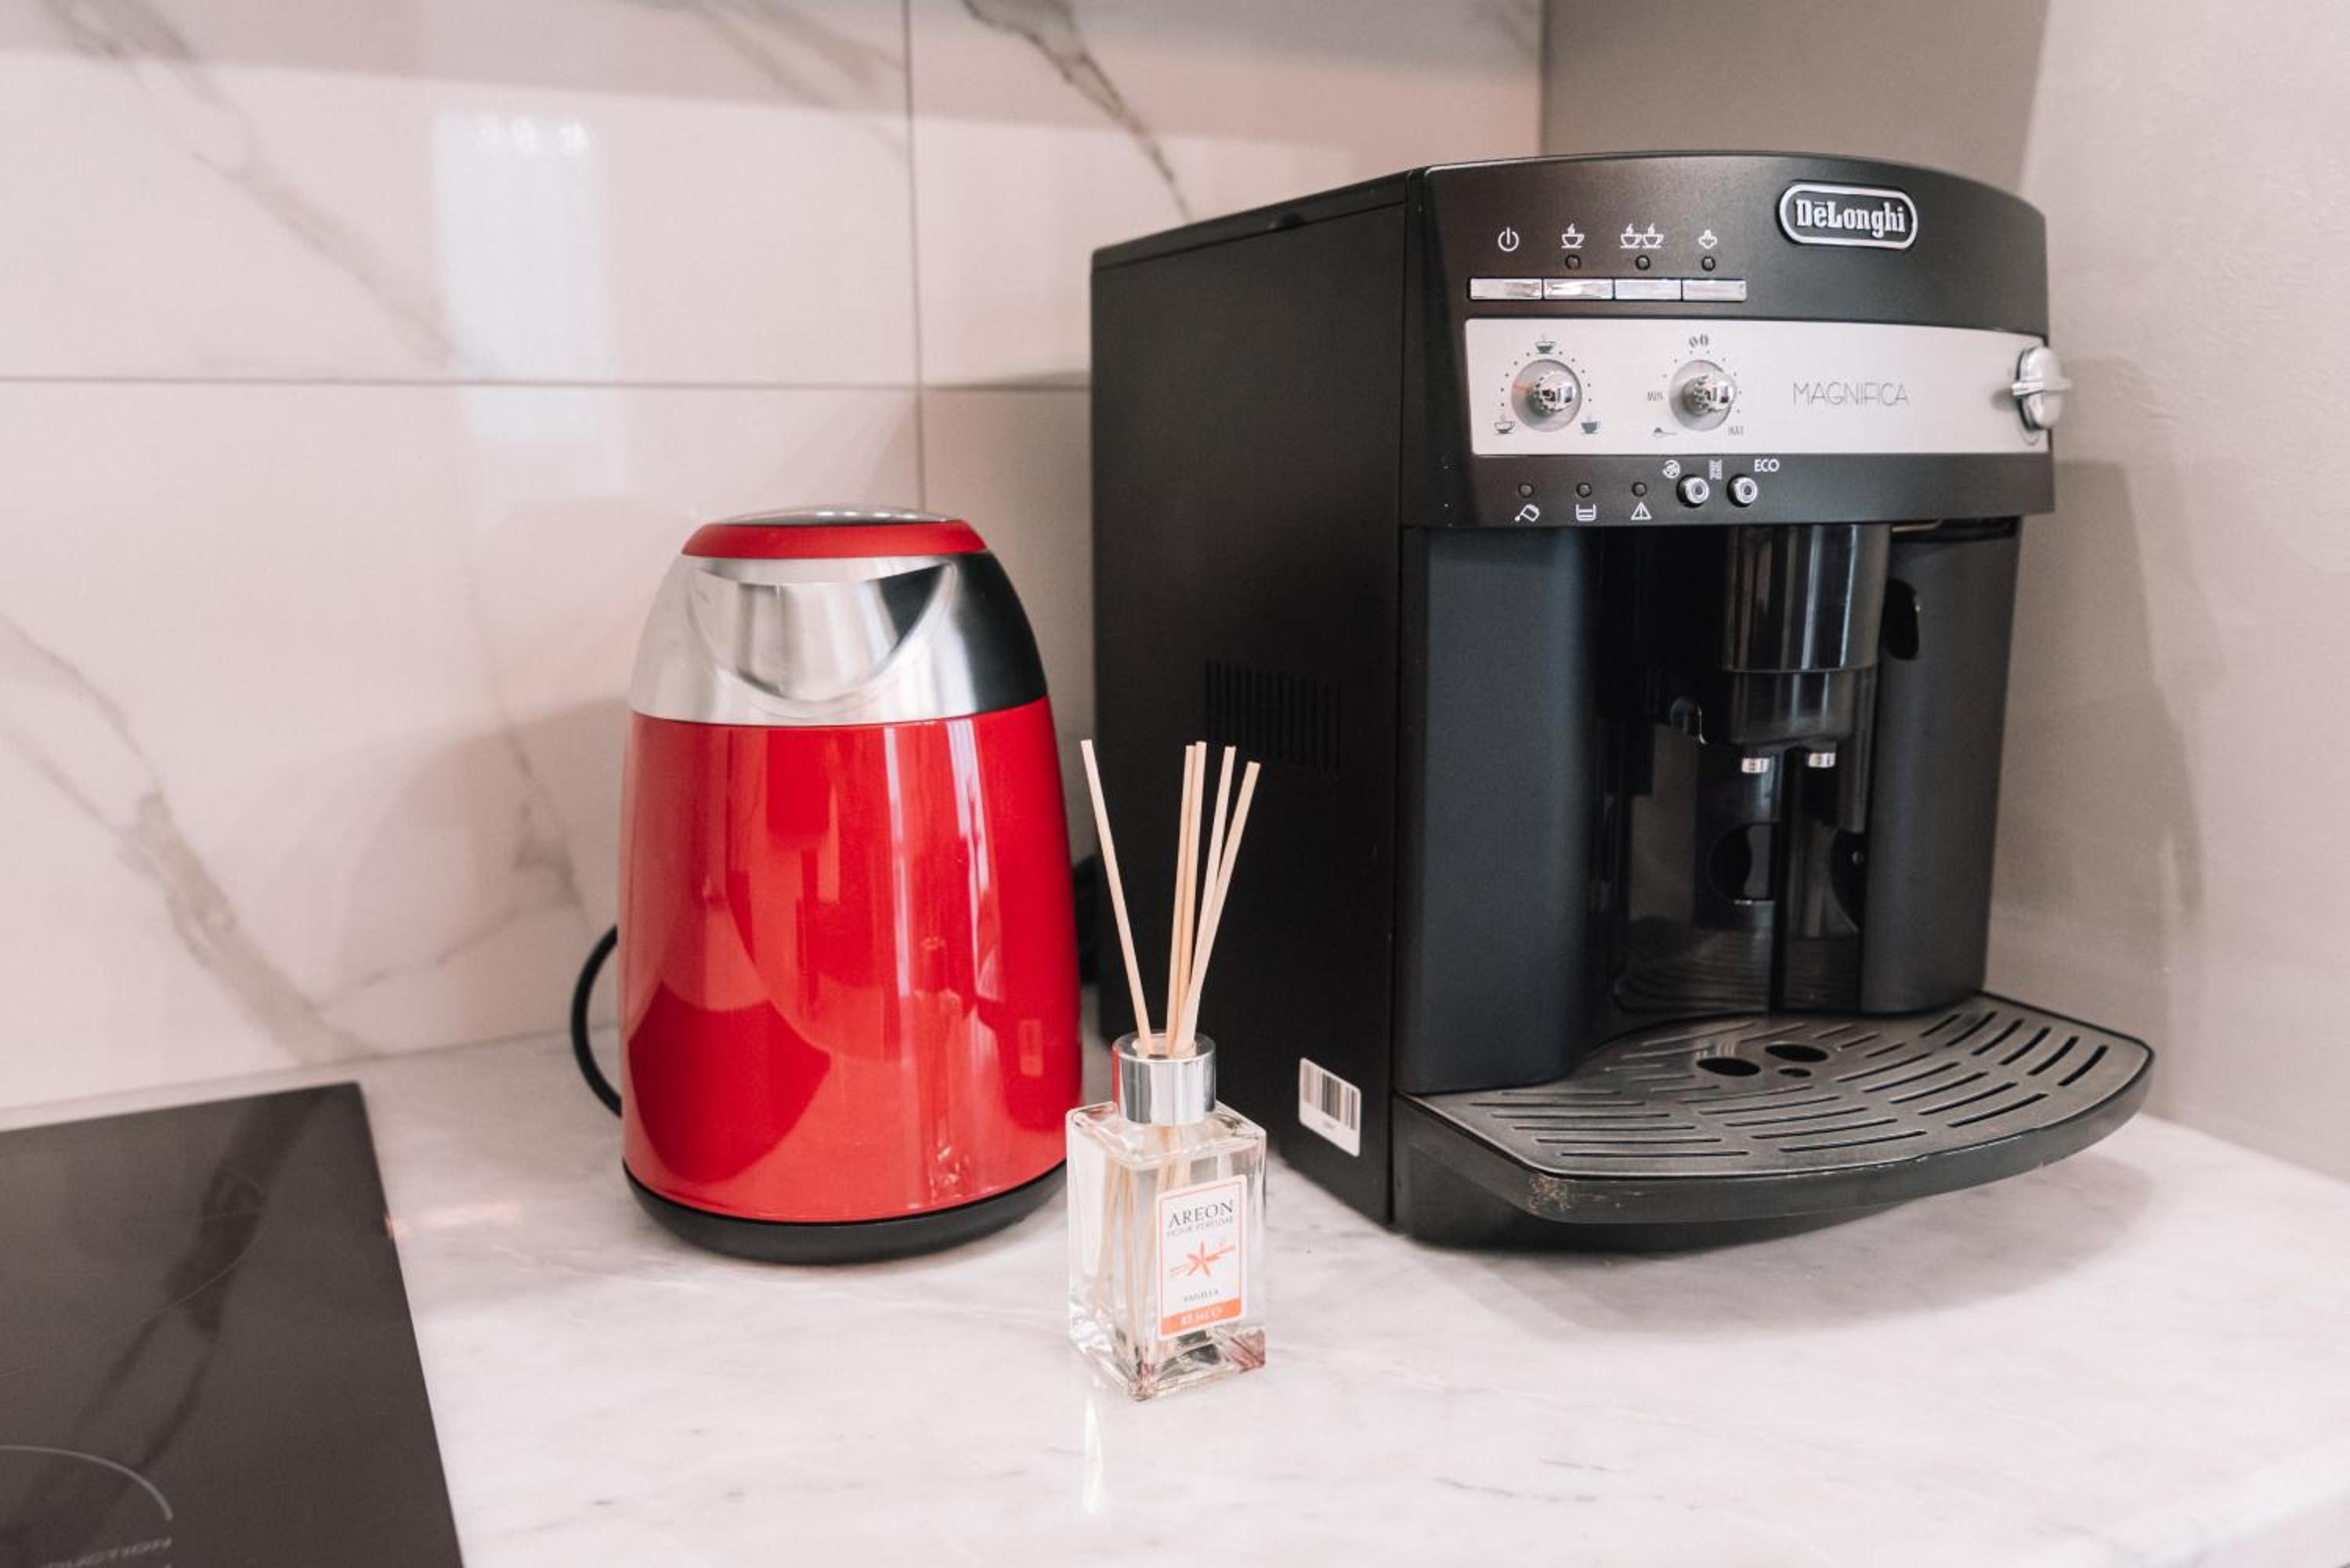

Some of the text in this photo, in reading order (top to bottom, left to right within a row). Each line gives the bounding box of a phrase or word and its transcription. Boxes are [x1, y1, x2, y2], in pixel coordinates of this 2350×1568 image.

[1792, 381, 1908, 406] MAGNIFICA
[1728, 425, 1744, 436] MAX
[1754, 458, 1780, 472] ECO
[1169, 1198, 1233, 1228] AREON
